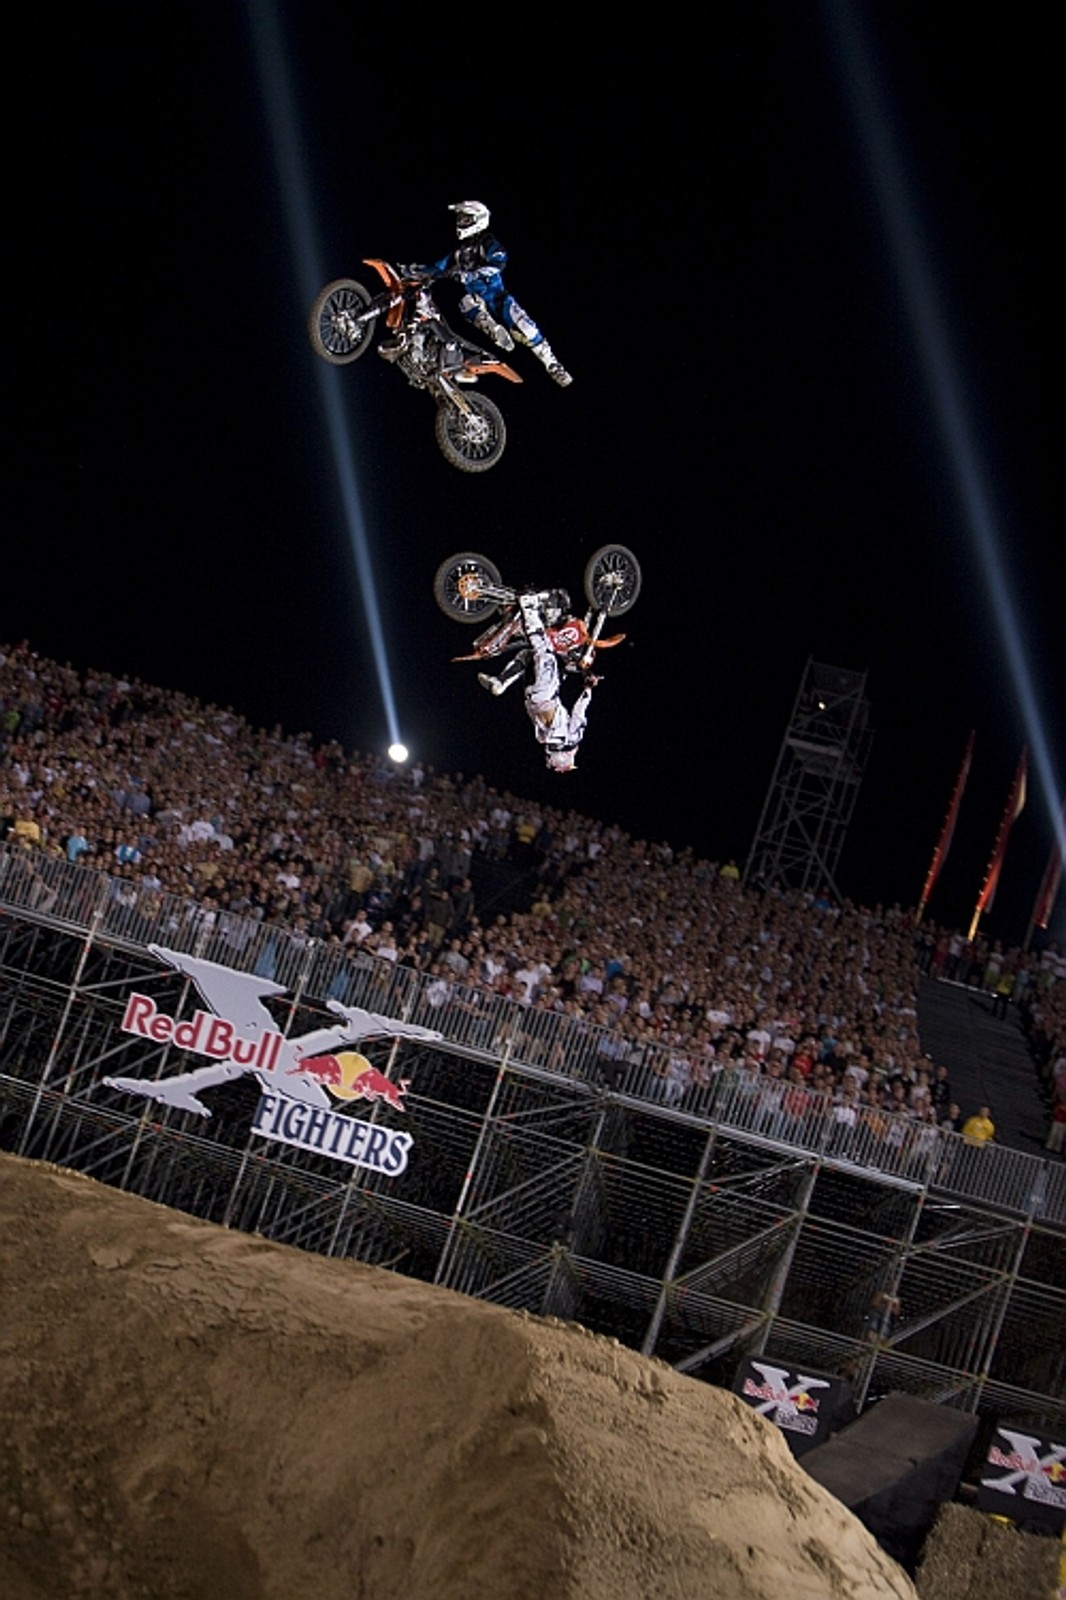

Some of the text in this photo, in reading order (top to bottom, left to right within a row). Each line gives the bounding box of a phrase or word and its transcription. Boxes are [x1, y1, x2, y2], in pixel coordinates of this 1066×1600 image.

[122, 995, 284, 1071] Red Bull
[252, 1095, 412, 1174] FIGHTERS
